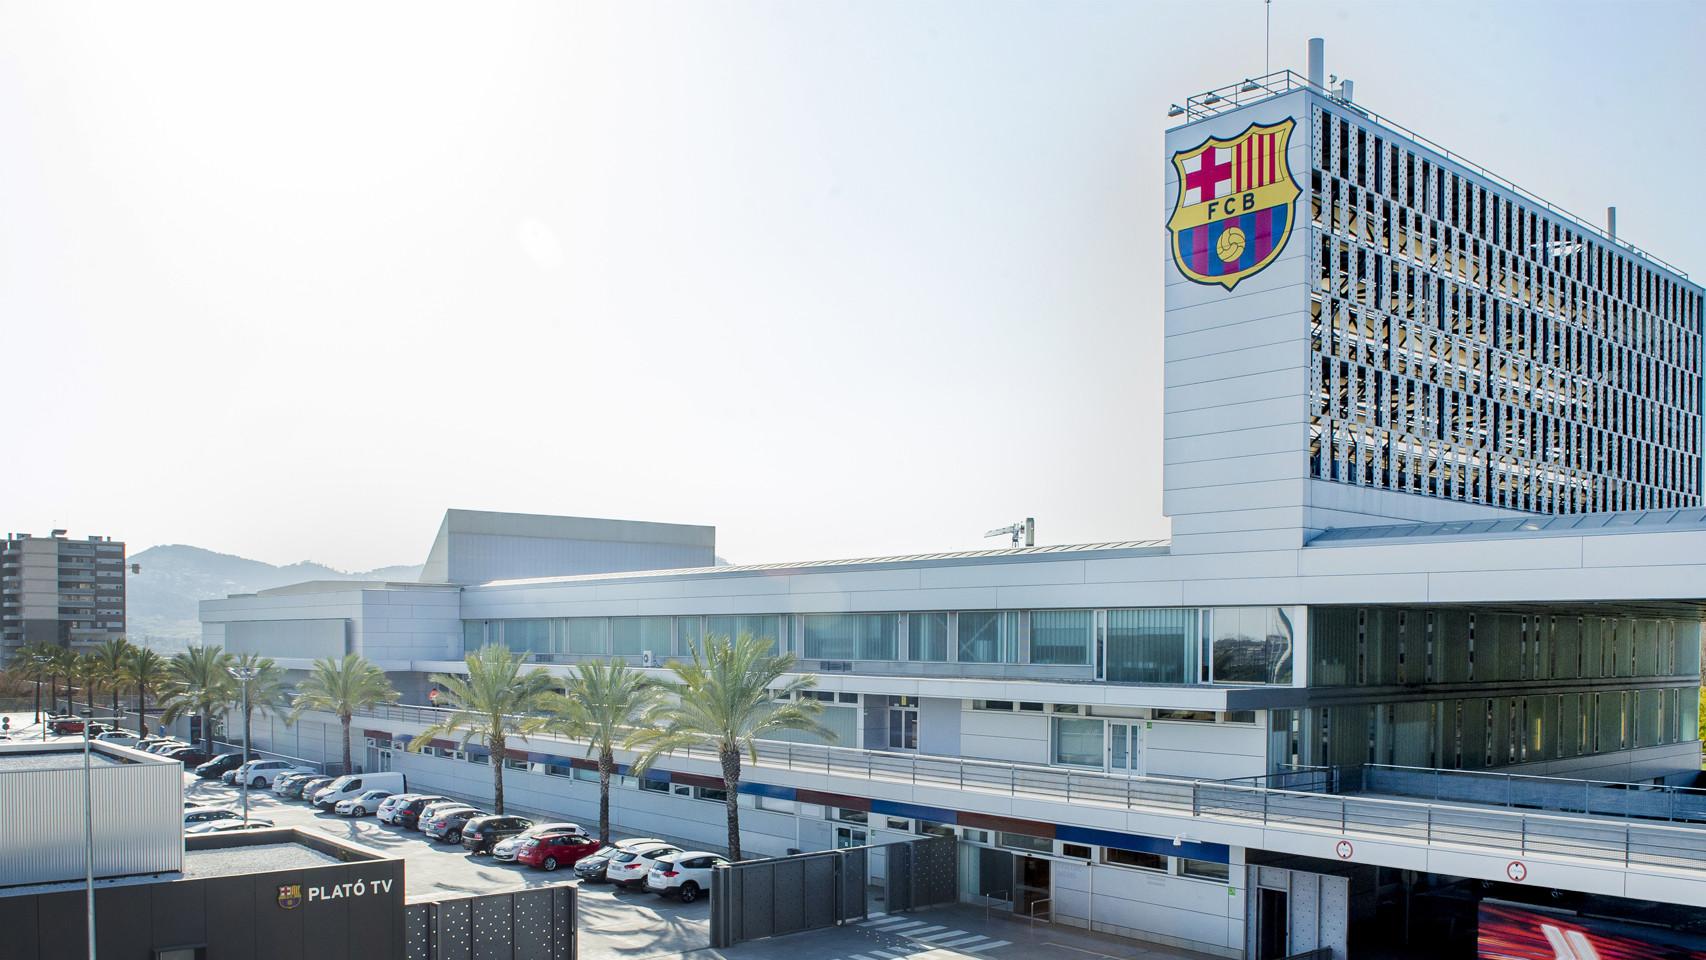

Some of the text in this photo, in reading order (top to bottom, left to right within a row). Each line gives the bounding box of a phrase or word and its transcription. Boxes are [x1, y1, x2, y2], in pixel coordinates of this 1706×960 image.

[1208, 192, 1255, 220] FCB
[308, 879, 393, 901] PLATÓ TV
